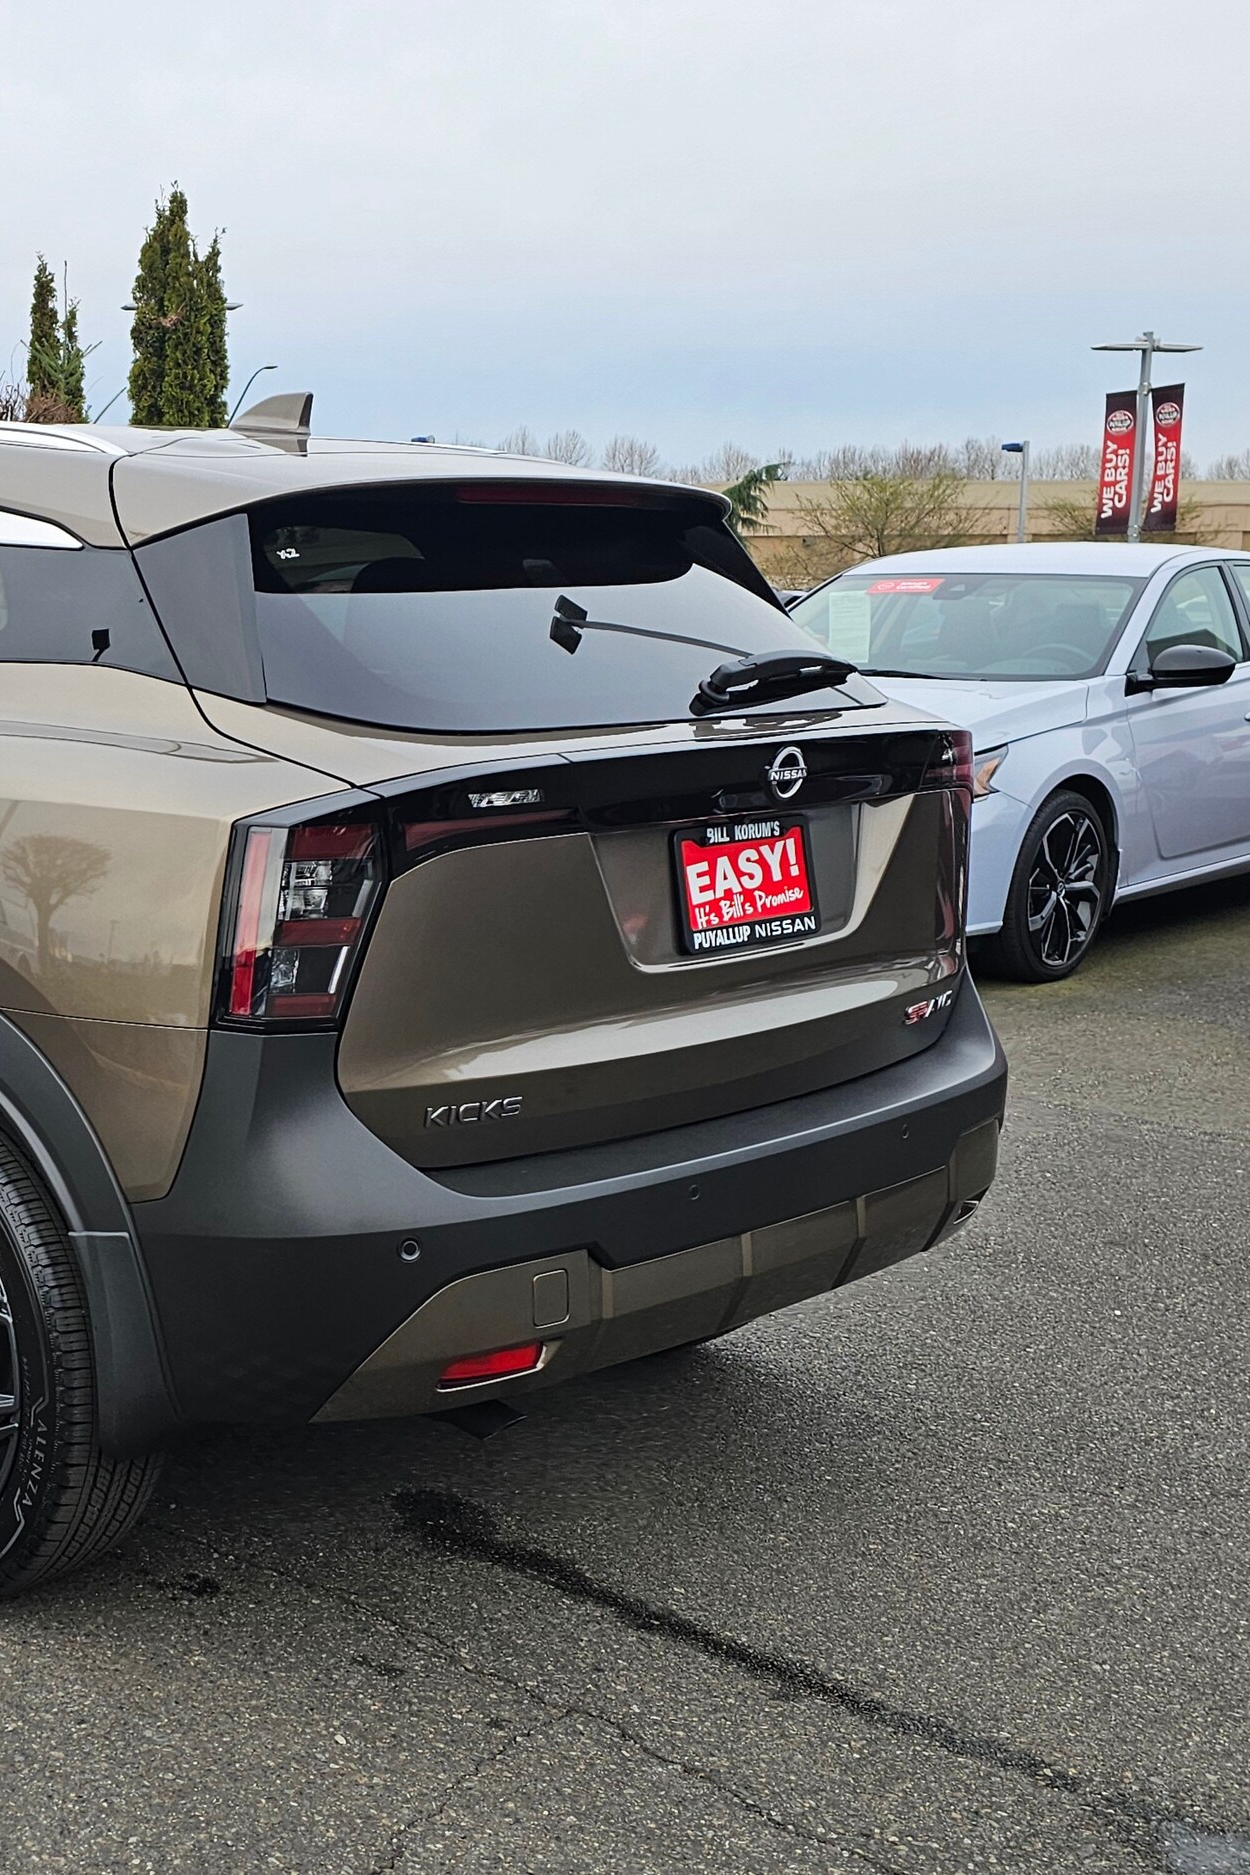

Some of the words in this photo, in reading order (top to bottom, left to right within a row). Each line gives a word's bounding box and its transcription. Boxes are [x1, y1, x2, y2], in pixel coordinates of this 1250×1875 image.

[1104, 440, 1118, 482] BUY
[1114, 449, 1130, 508] CARS!
[1150, 481, 1164, 513] WE
[1157, 432, 1167, 475] BUY
[1163, 441, 1177, 503] CARS!
[1101, 486, 1114, 519] WE
[770, 768, 808, 781] NISSAN
[707, 827, 730, 844] BILL
[734, 820, 780, 841] KORUM'S
[686, 838, 799, 905] EASY!
[694, 905, 719, 929] It's
[719, 893, 754, 922] Bill's
[754, 886, 804, 912] Promise
[693, 925, 751, 949] PUYALLUP
[755, 916, 816, 938] NISSAN
[424, 1096, 522, 1128] KICKS
[22, 1418, 48, 1506] ALENZA
